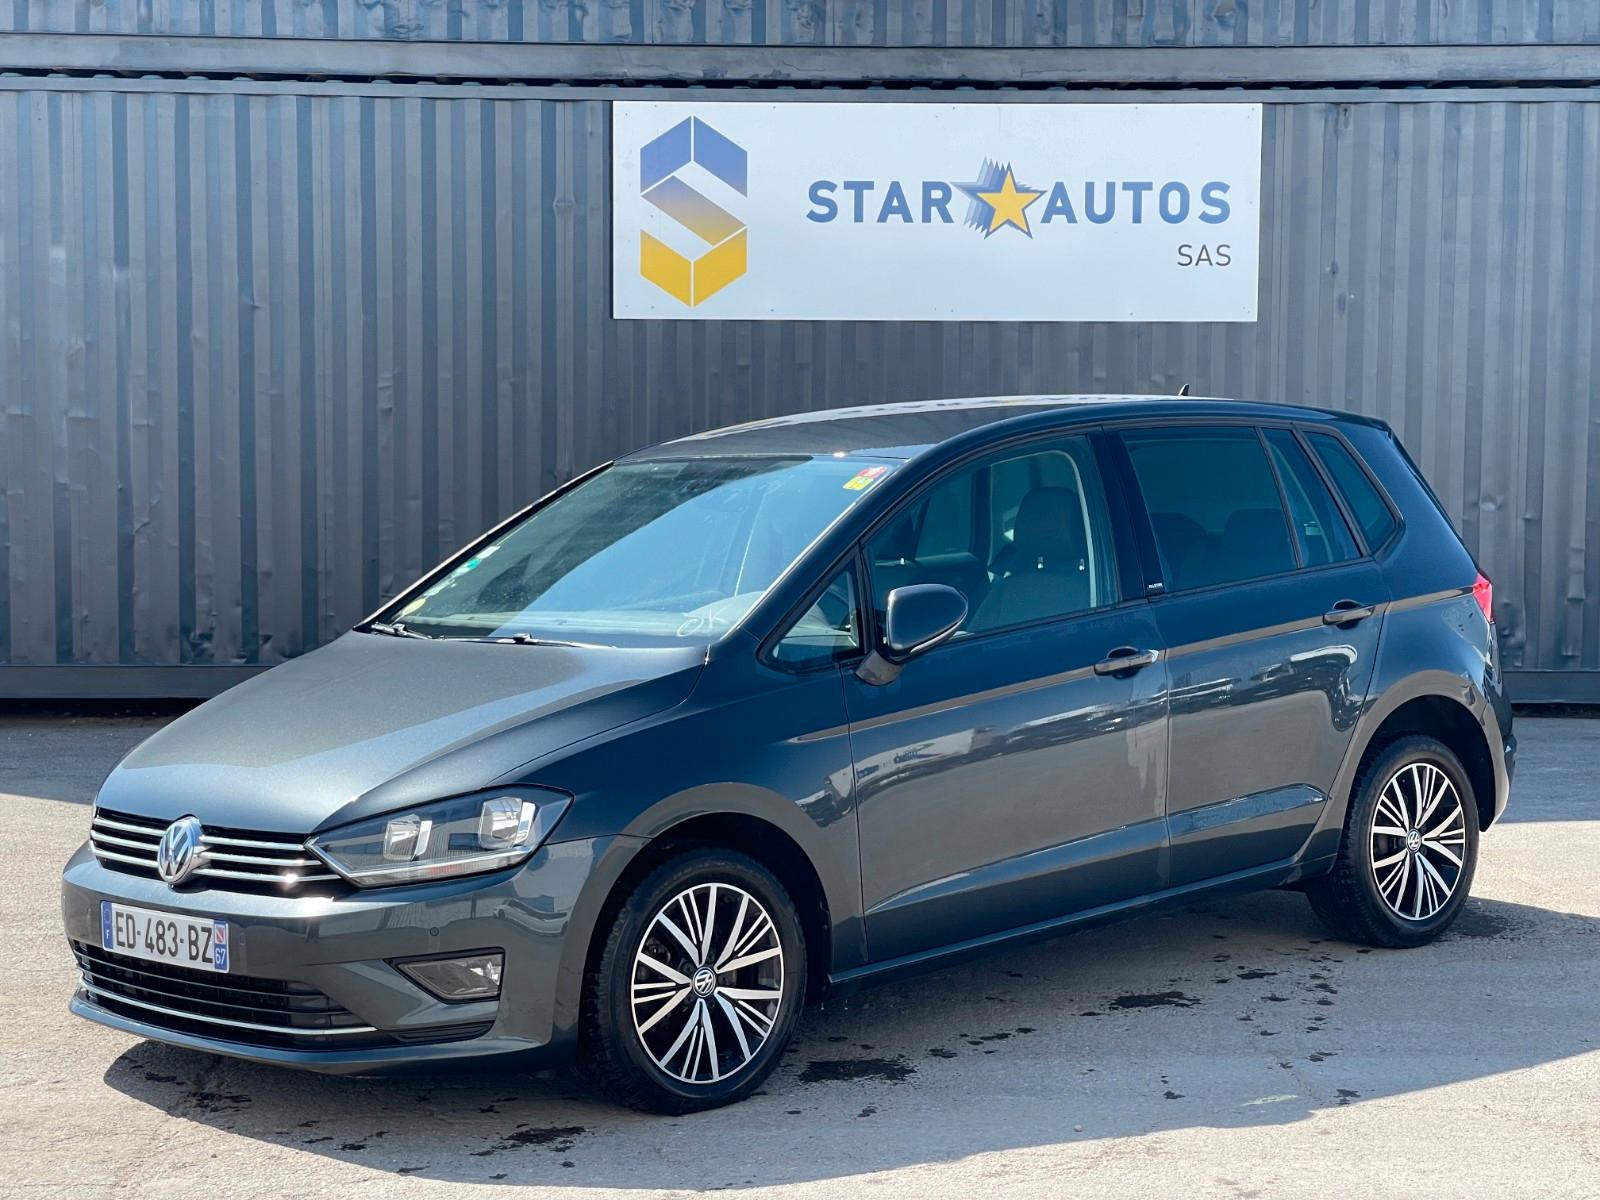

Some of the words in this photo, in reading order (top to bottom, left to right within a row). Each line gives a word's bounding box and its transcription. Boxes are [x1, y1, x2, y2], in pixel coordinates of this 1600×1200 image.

[806, 179, 955, 225] STAR
[1040, 181, 1231, 225] AUTOS
[1177, 244, 1232, 267] SAS
[115, 911, 213, 964] ED-483-BZ
[215, 947, 226, 965] 67
